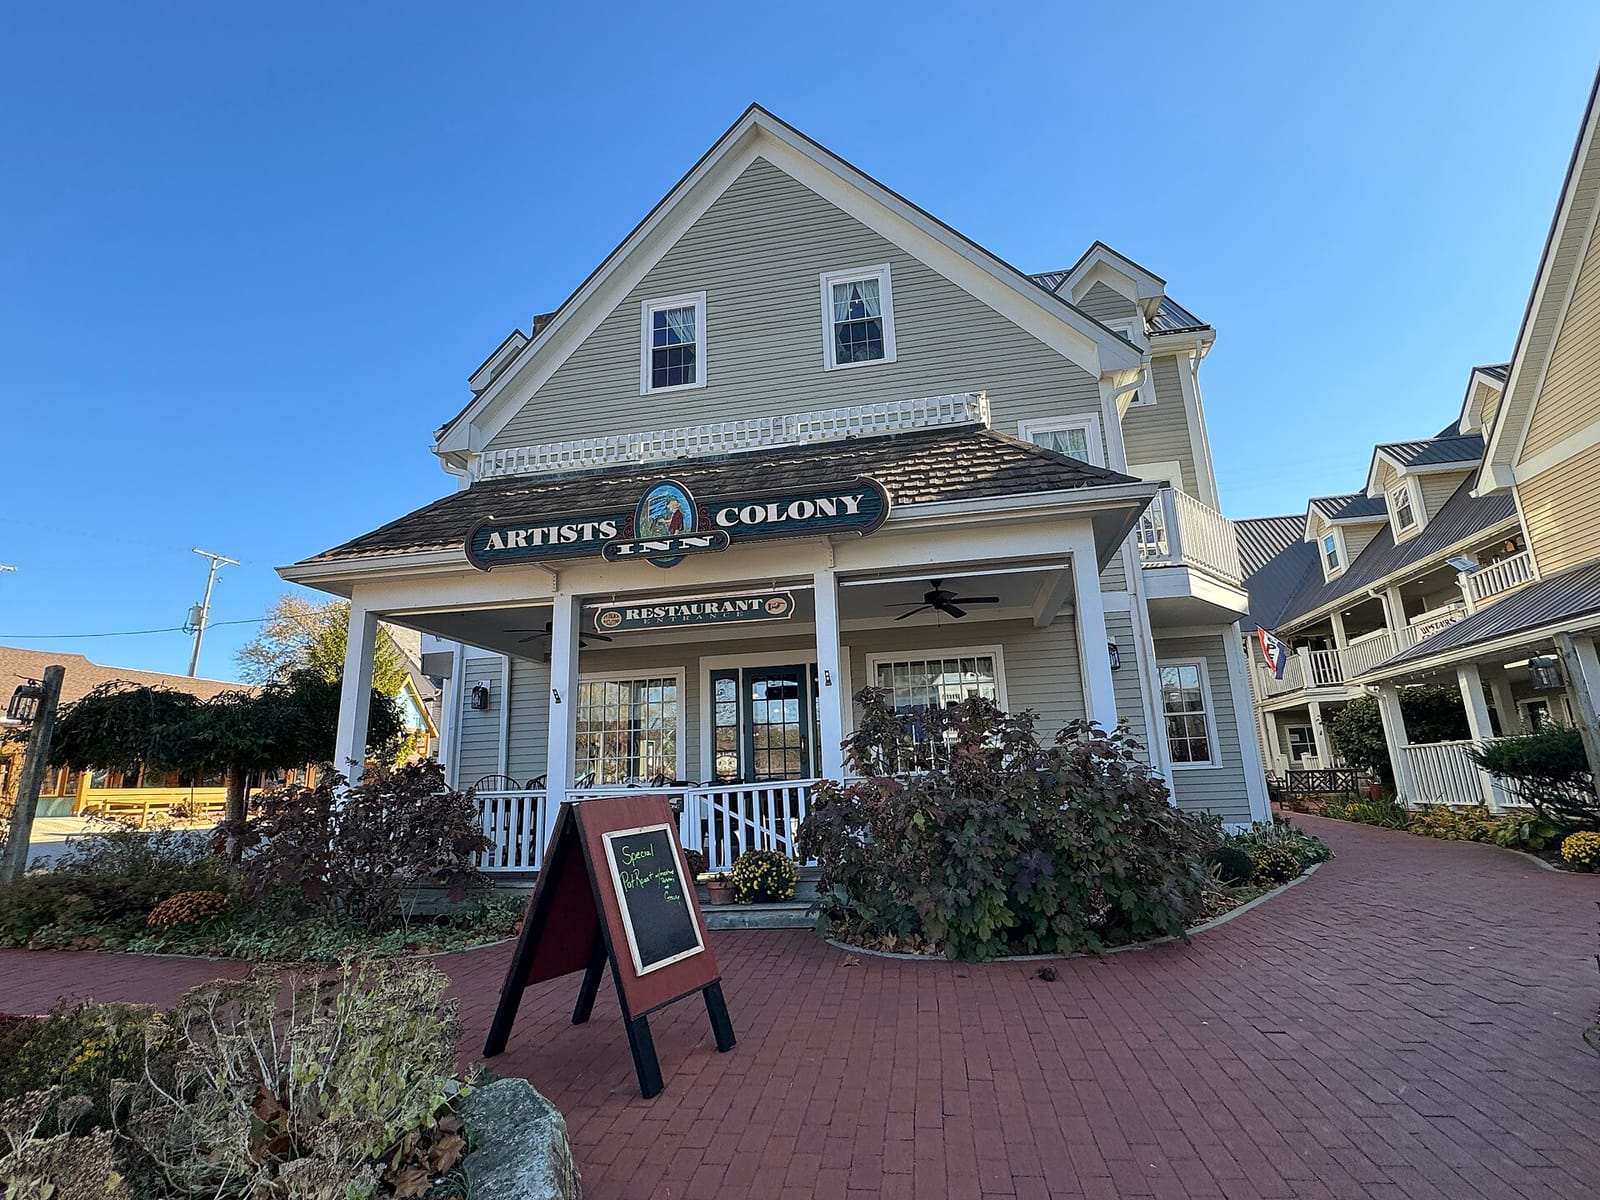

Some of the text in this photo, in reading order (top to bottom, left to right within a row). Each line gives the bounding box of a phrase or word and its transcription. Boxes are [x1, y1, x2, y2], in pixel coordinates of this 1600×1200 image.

[716, 494, 865, 528] COLONY
[484, 520, 618, 552] ARTISTS
[617, 535, 714, 555] INN
[625, 598, 763, 620] RESTAURANT
[643, 612, 745, 625] ENTRANCE
[621, 843, 654, 867] Special
